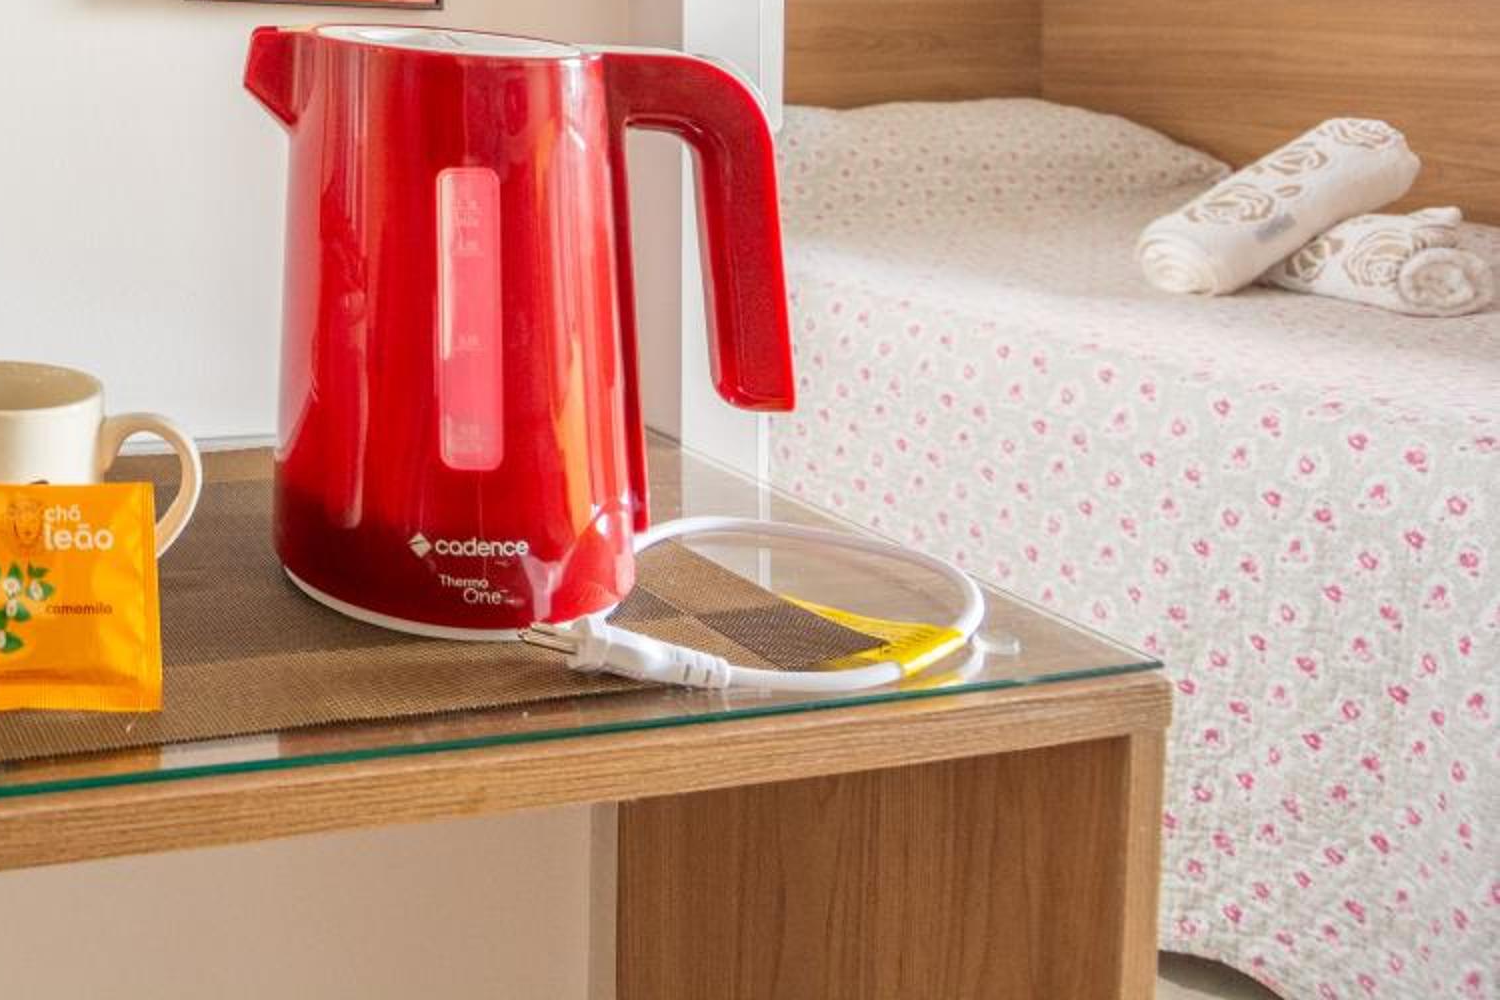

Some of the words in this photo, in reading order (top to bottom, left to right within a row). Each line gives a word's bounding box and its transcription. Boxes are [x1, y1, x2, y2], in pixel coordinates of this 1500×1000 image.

[43, 520, 115, 552] leão
[434, 536, 530, 557] cadence
[438, 573, 490, 590] Thermo
[463, 587, 502, 605] One
